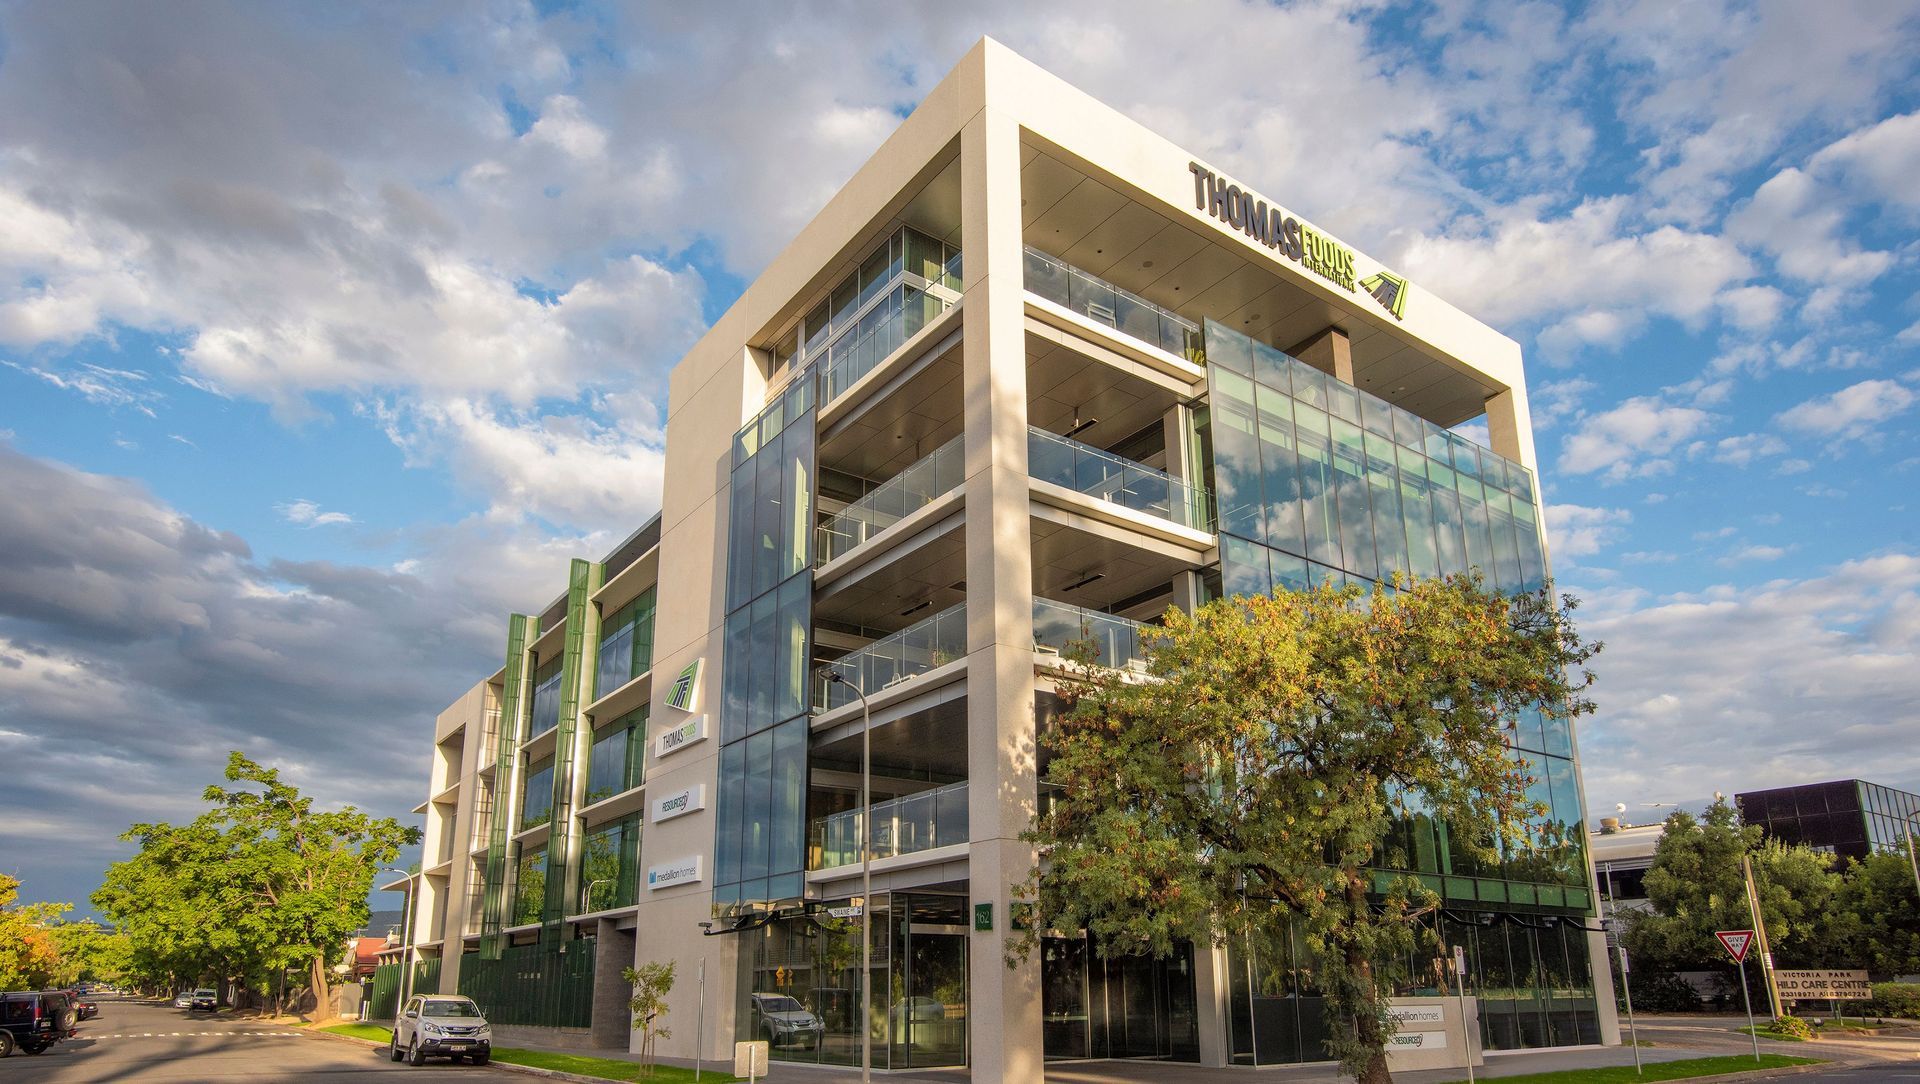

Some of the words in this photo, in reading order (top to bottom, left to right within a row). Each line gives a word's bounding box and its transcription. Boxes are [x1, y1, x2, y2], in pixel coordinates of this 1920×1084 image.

[1189, 161, 1302, 262] THOMAS
[1301, 224, 1357, 282] FOODS
[662, 727, 684, 751] THOMAS
[657, 871, 680, 883] medallion
[680, 866, 696, 880] homes
[976, 911, 990, 925] 162
[1776, 980, 1798, 990] HILD
[1801, 980, 1828, 990] CARE
[1830, 980, 1870, 990] CENTRE
[1418, 1010, 1439, 1020] homes
